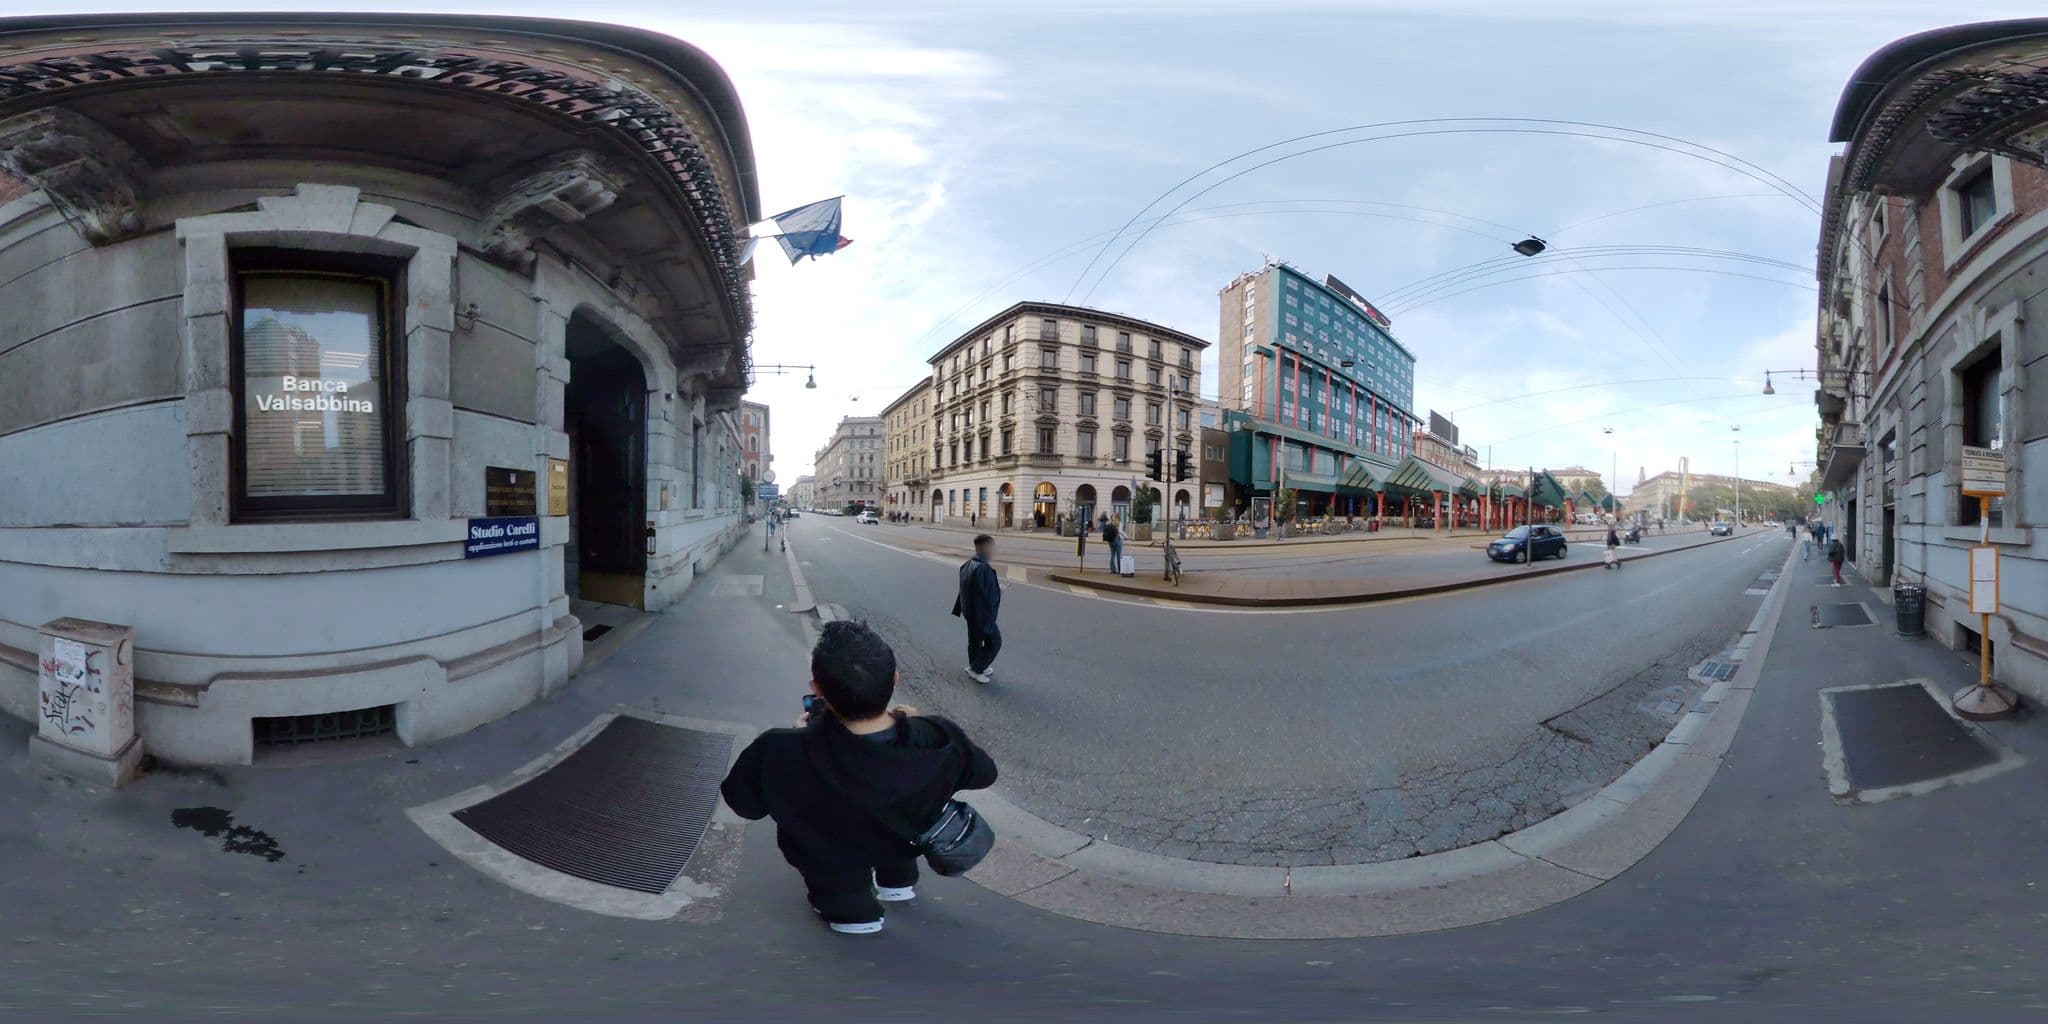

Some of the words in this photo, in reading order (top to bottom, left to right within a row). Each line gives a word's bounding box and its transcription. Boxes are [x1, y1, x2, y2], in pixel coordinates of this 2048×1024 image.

[282, 375, 348, 393] Banca
[255, 394, 374, 413] Valsabbina
[471, 525, 504, 539] Studio
[506, 522, 536, 536] Carelli
